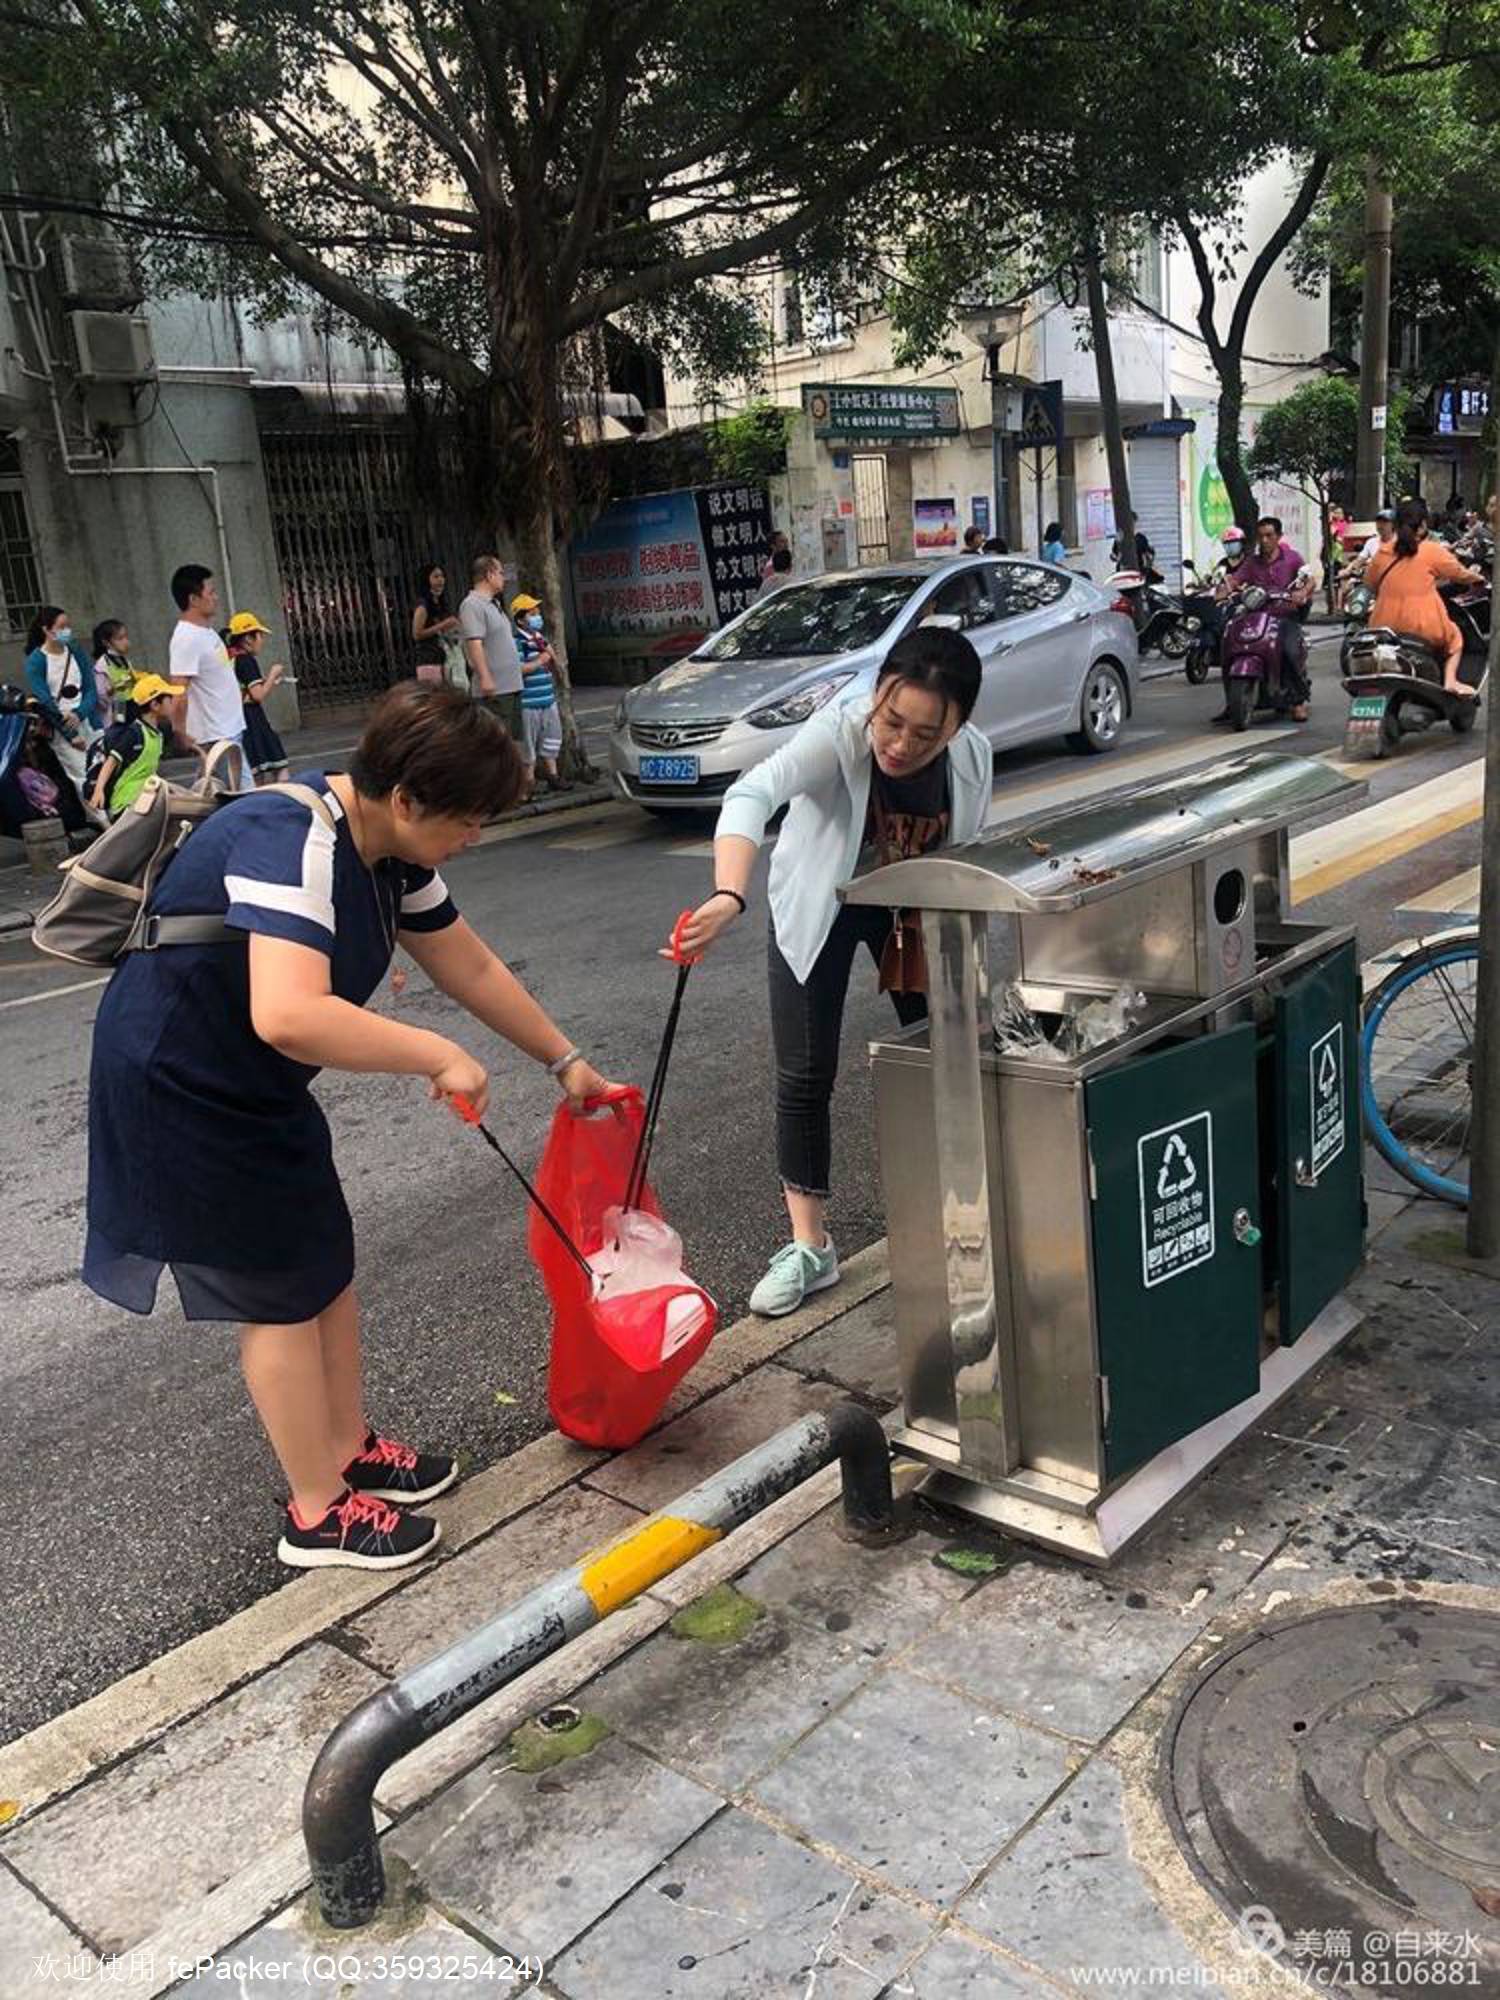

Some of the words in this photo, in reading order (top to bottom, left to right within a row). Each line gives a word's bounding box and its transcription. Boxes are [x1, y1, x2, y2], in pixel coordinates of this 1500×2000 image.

[708, 488, 765, 516] 说文明话
[711, 519, 767, 548] 做文明人
[1152, 1190, 1203, 1224] 可回收物
